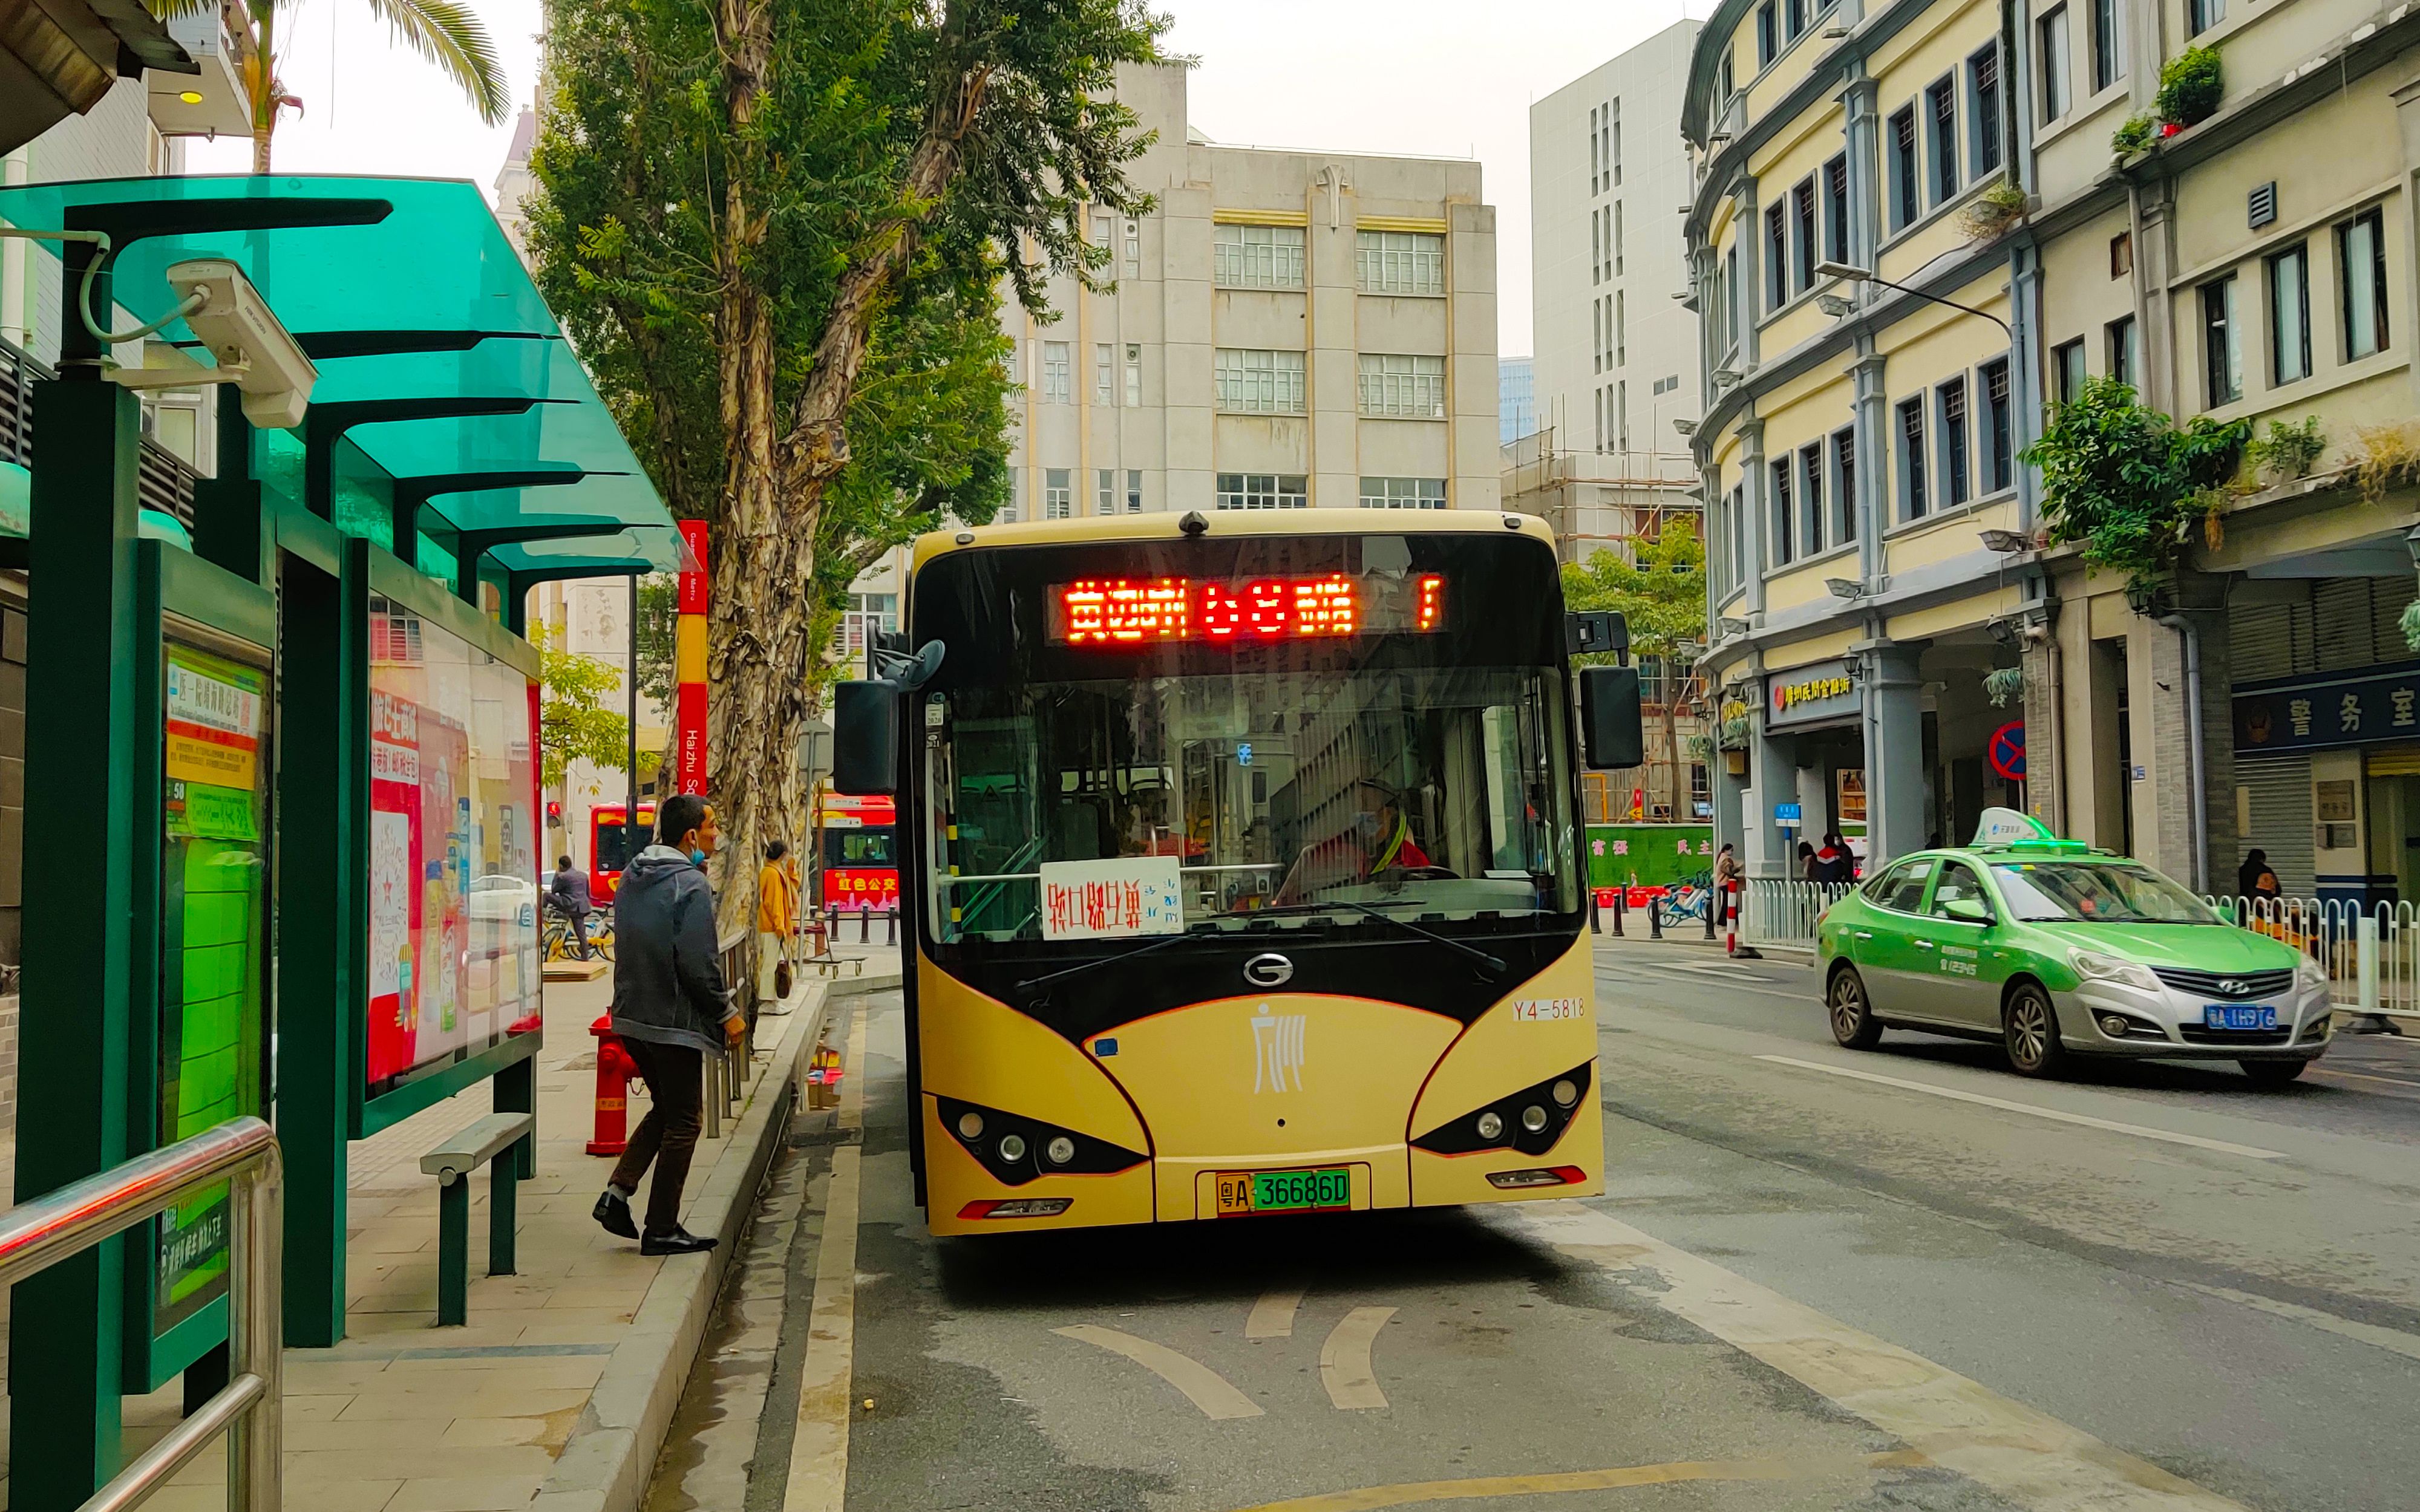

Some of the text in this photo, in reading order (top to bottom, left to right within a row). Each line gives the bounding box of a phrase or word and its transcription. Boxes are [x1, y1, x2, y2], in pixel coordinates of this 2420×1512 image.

[2289, 686, 2416, 736] 警务室
[686, 730, 698, 772] Haizhu
[1677, 839, 1713, 856] 民主
[839, 878, 896, 891] 红色公交
[1514, 998, 1584, 1020] Y4-5818
